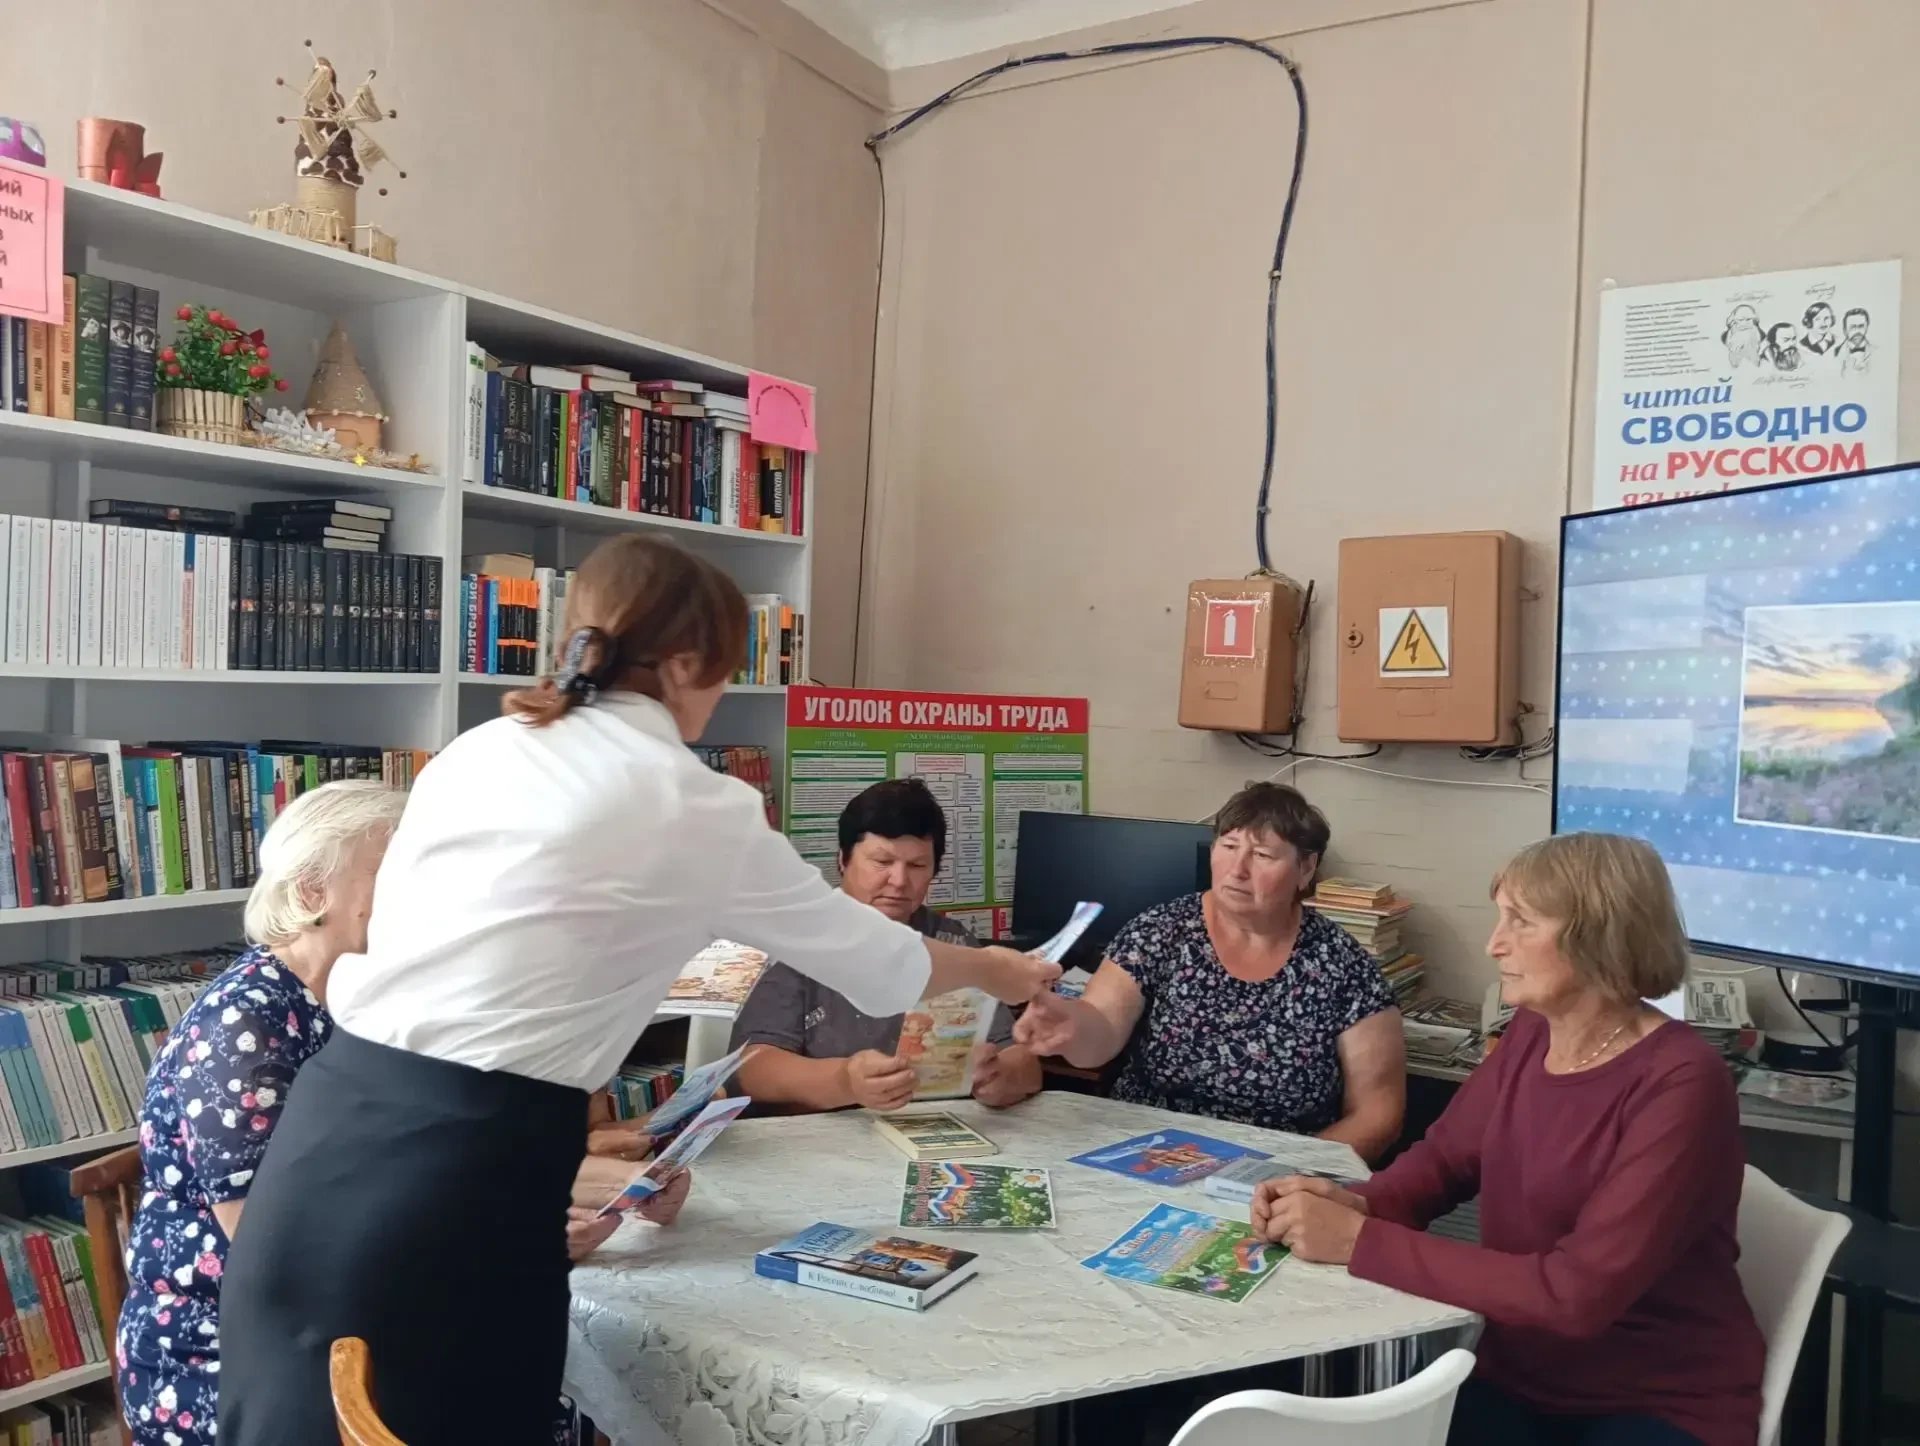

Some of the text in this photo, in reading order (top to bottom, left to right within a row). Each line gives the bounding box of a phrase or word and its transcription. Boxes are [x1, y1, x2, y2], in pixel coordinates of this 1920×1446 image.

[1623, 376, 1734, 409] читай
[1621, 402, 1868, 445] СВОБОДНО
[1619, 442, 1867, 482] на РУССКОМ
[774, 471, 783, 515] ШОЛОХОВ
[804, 696, 1069, 731] УГОЛОК ОХРАНЫ ТРУДА
